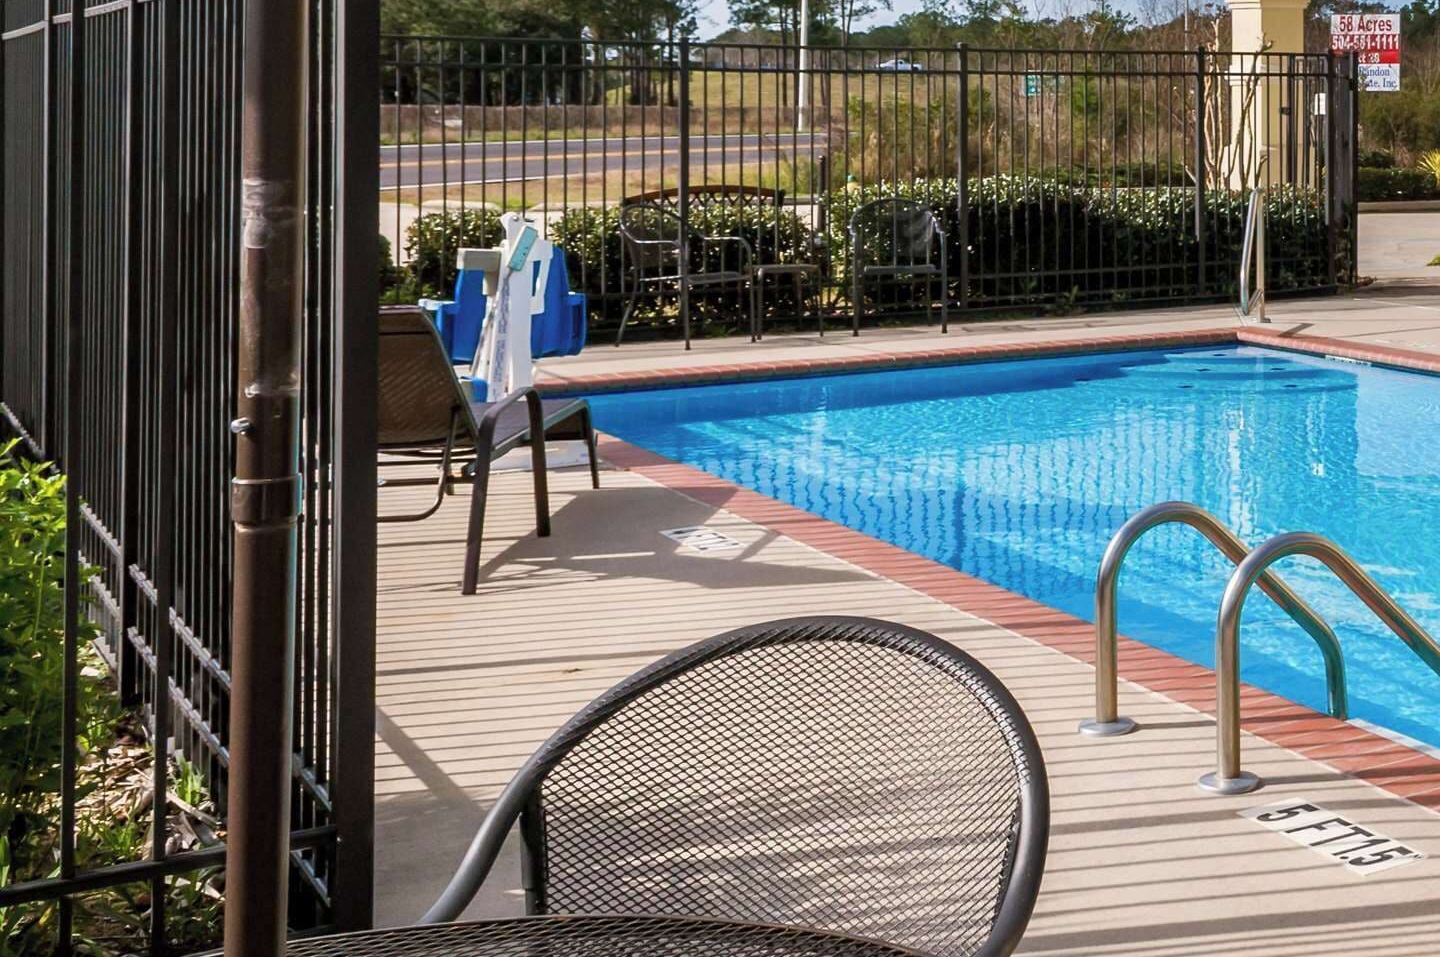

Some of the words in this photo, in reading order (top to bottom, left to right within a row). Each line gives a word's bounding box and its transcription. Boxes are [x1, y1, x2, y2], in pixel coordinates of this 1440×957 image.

[1339, 16, 1354, 32] 58
[1358, 15, 1393, 32] Acres
[1256, 802, 1321, 822] 5
